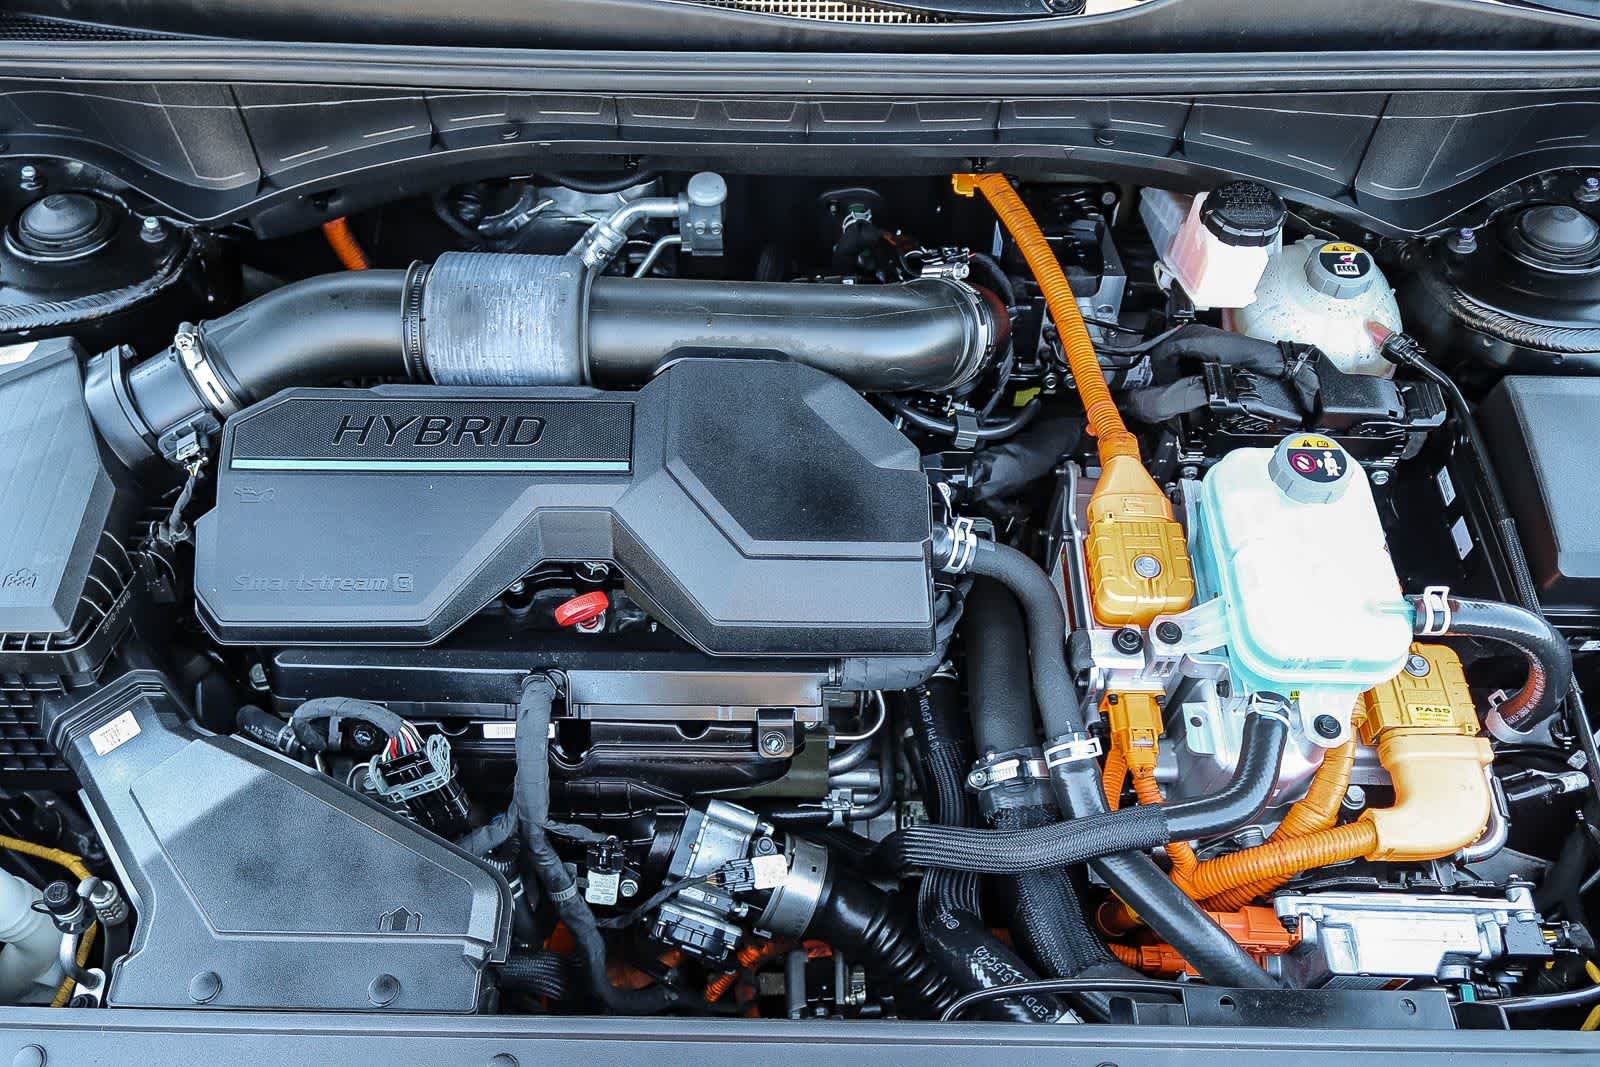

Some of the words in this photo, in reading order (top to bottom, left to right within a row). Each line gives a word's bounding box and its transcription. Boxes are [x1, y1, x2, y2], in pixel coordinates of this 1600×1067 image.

[331, 414, 548, 447] HYBRID
[231, 575, 388, 593] Smartstream
[1415, 706, 1451, 714] PASS
